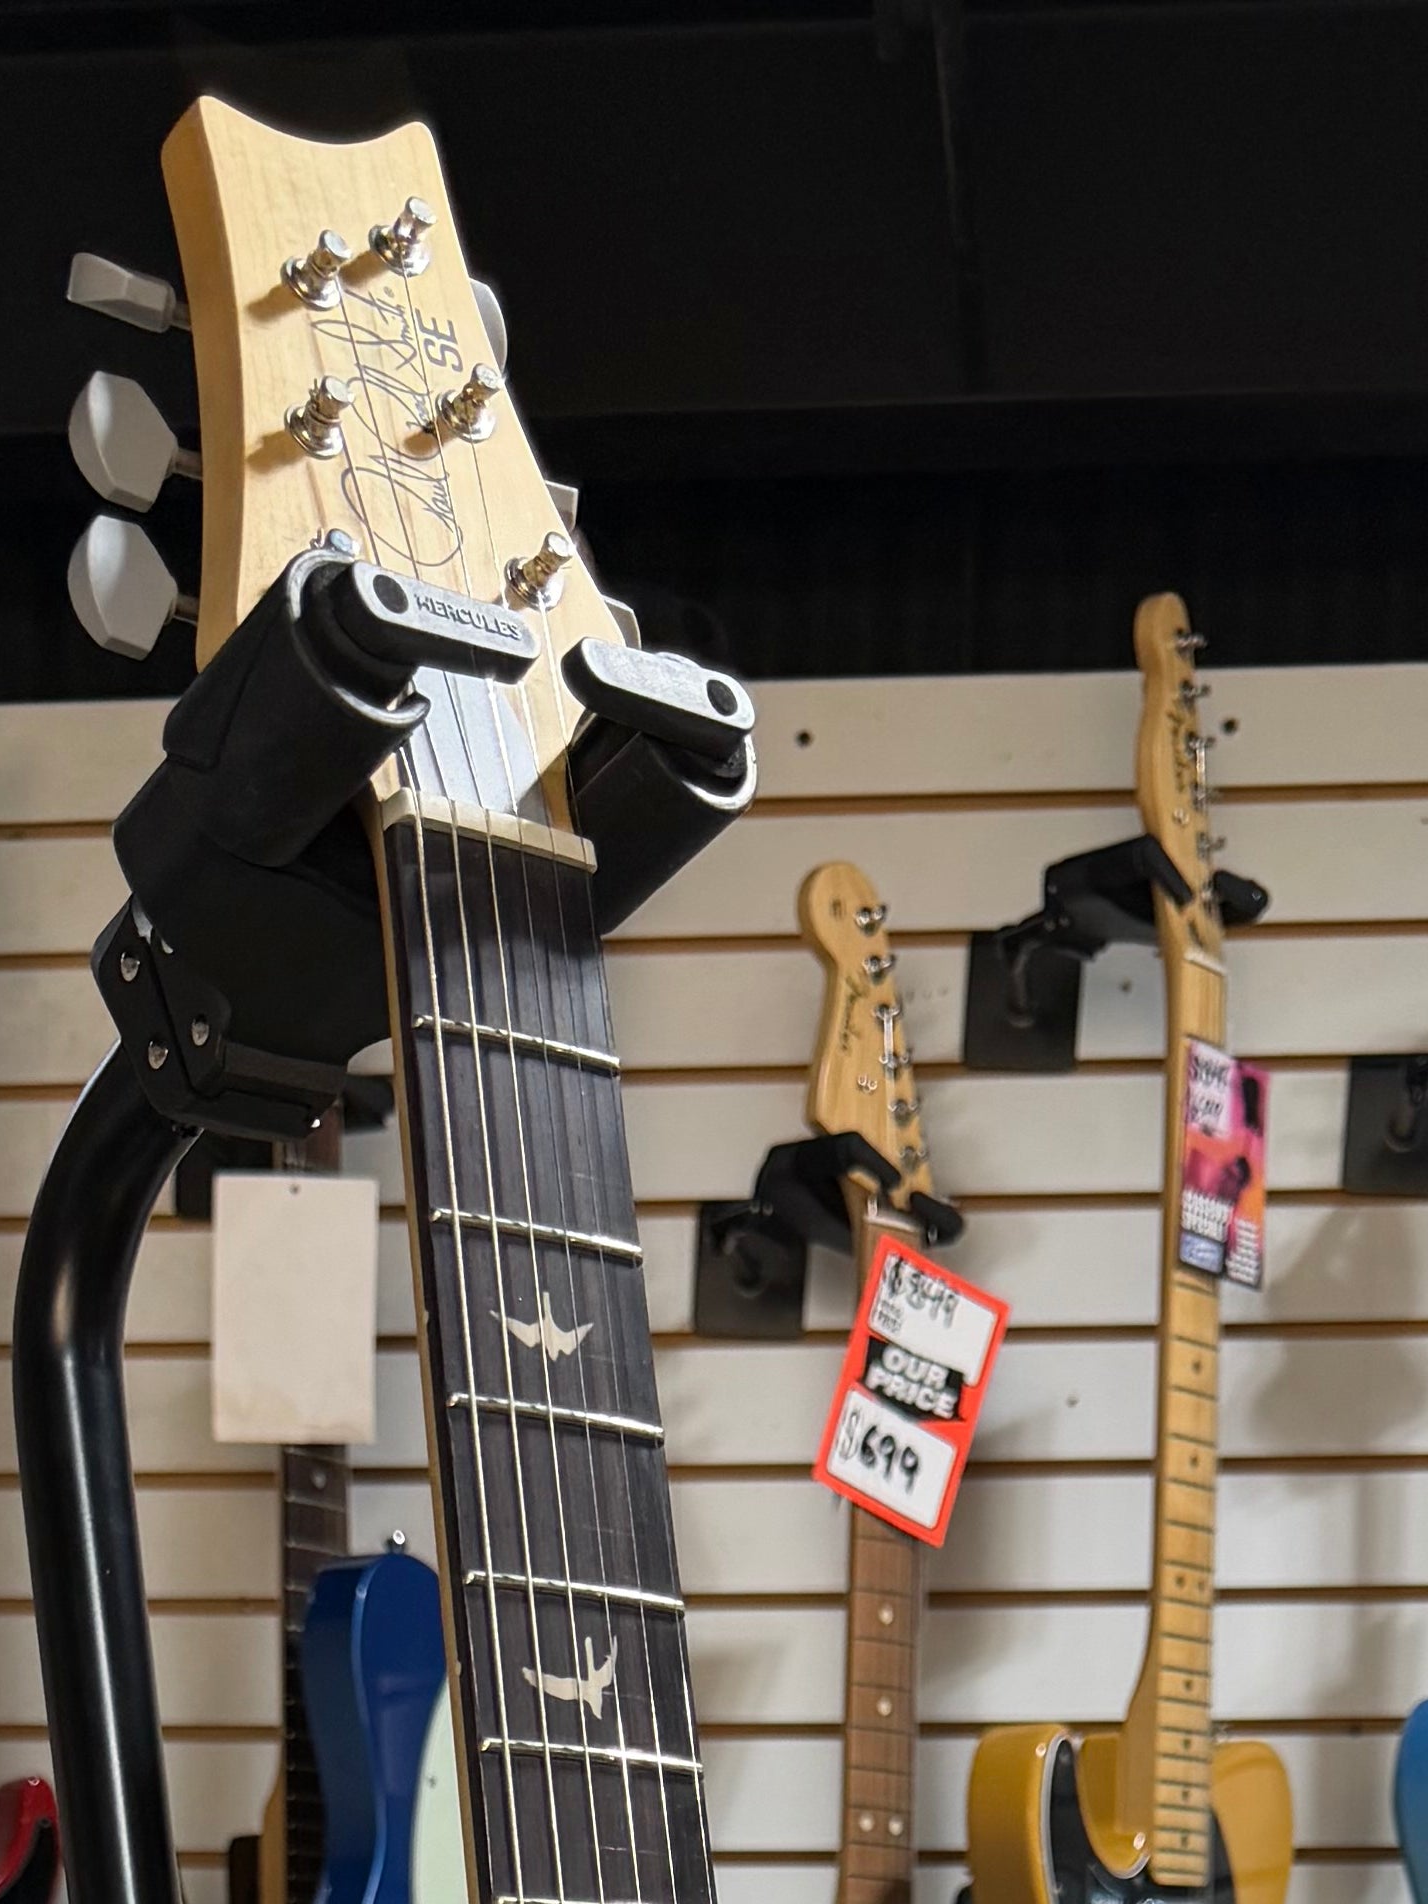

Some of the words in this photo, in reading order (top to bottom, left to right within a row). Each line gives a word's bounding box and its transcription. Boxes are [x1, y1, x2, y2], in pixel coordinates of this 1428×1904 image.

[417, 314, 464, 373] SE
[414, 592, 523, 641] HERCULES
[864, 1360, 962, 1421] PRICE
[881, 1347, 952, 1391] OUR
[837, 1408, 920, 1496] $699
